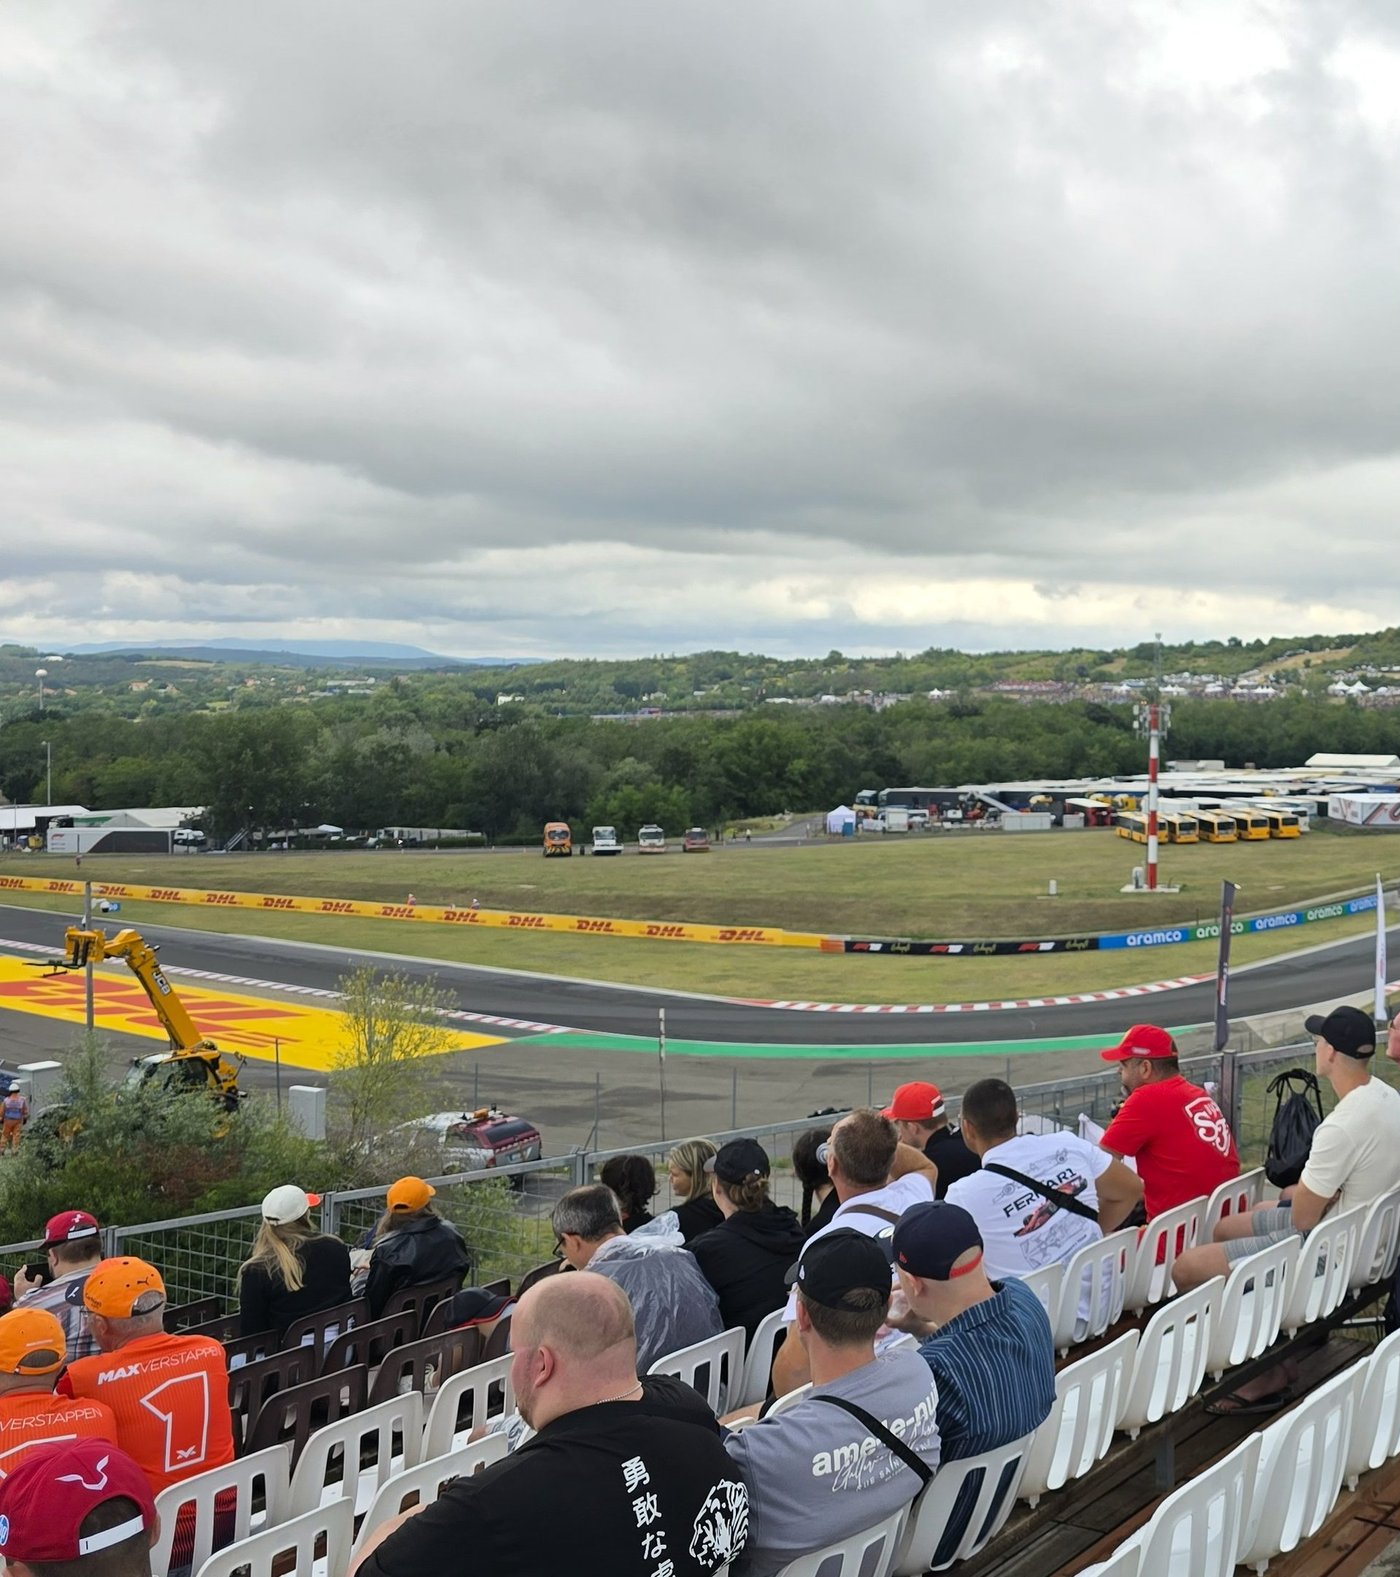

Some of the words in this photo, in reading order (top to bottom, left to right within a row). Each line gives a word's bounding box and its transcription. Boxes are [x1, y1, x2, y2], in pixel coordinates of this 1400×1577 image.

[48, 881, 76, 893] DHL
[99, 885, 129, 897] DHL
[150, 889, 182, 901] DHL
[206, 893, 237, 905] DHL
[263, 897, 296, 909] DHL
[321, 901, 355, 913] DHL
[381, 906, 416, 918] DHL
[443, 911, 480, 923] DHL
[1306, 905, 1343, 921] aramco
[508, 915, 546, 928] DHL
[576, 919, 615, 933] DHL
[1255, 913, 1298, 930] aramco
[646, 924, 686, 938] DHL
[719, 929, 767, 942] DHL
[1196, 920, 1244, 938] araco
[1126, 929, 1183, 946] aramco
[153, 971, 171, 995] JCB
[139, 1370, 209, 1473] 1
